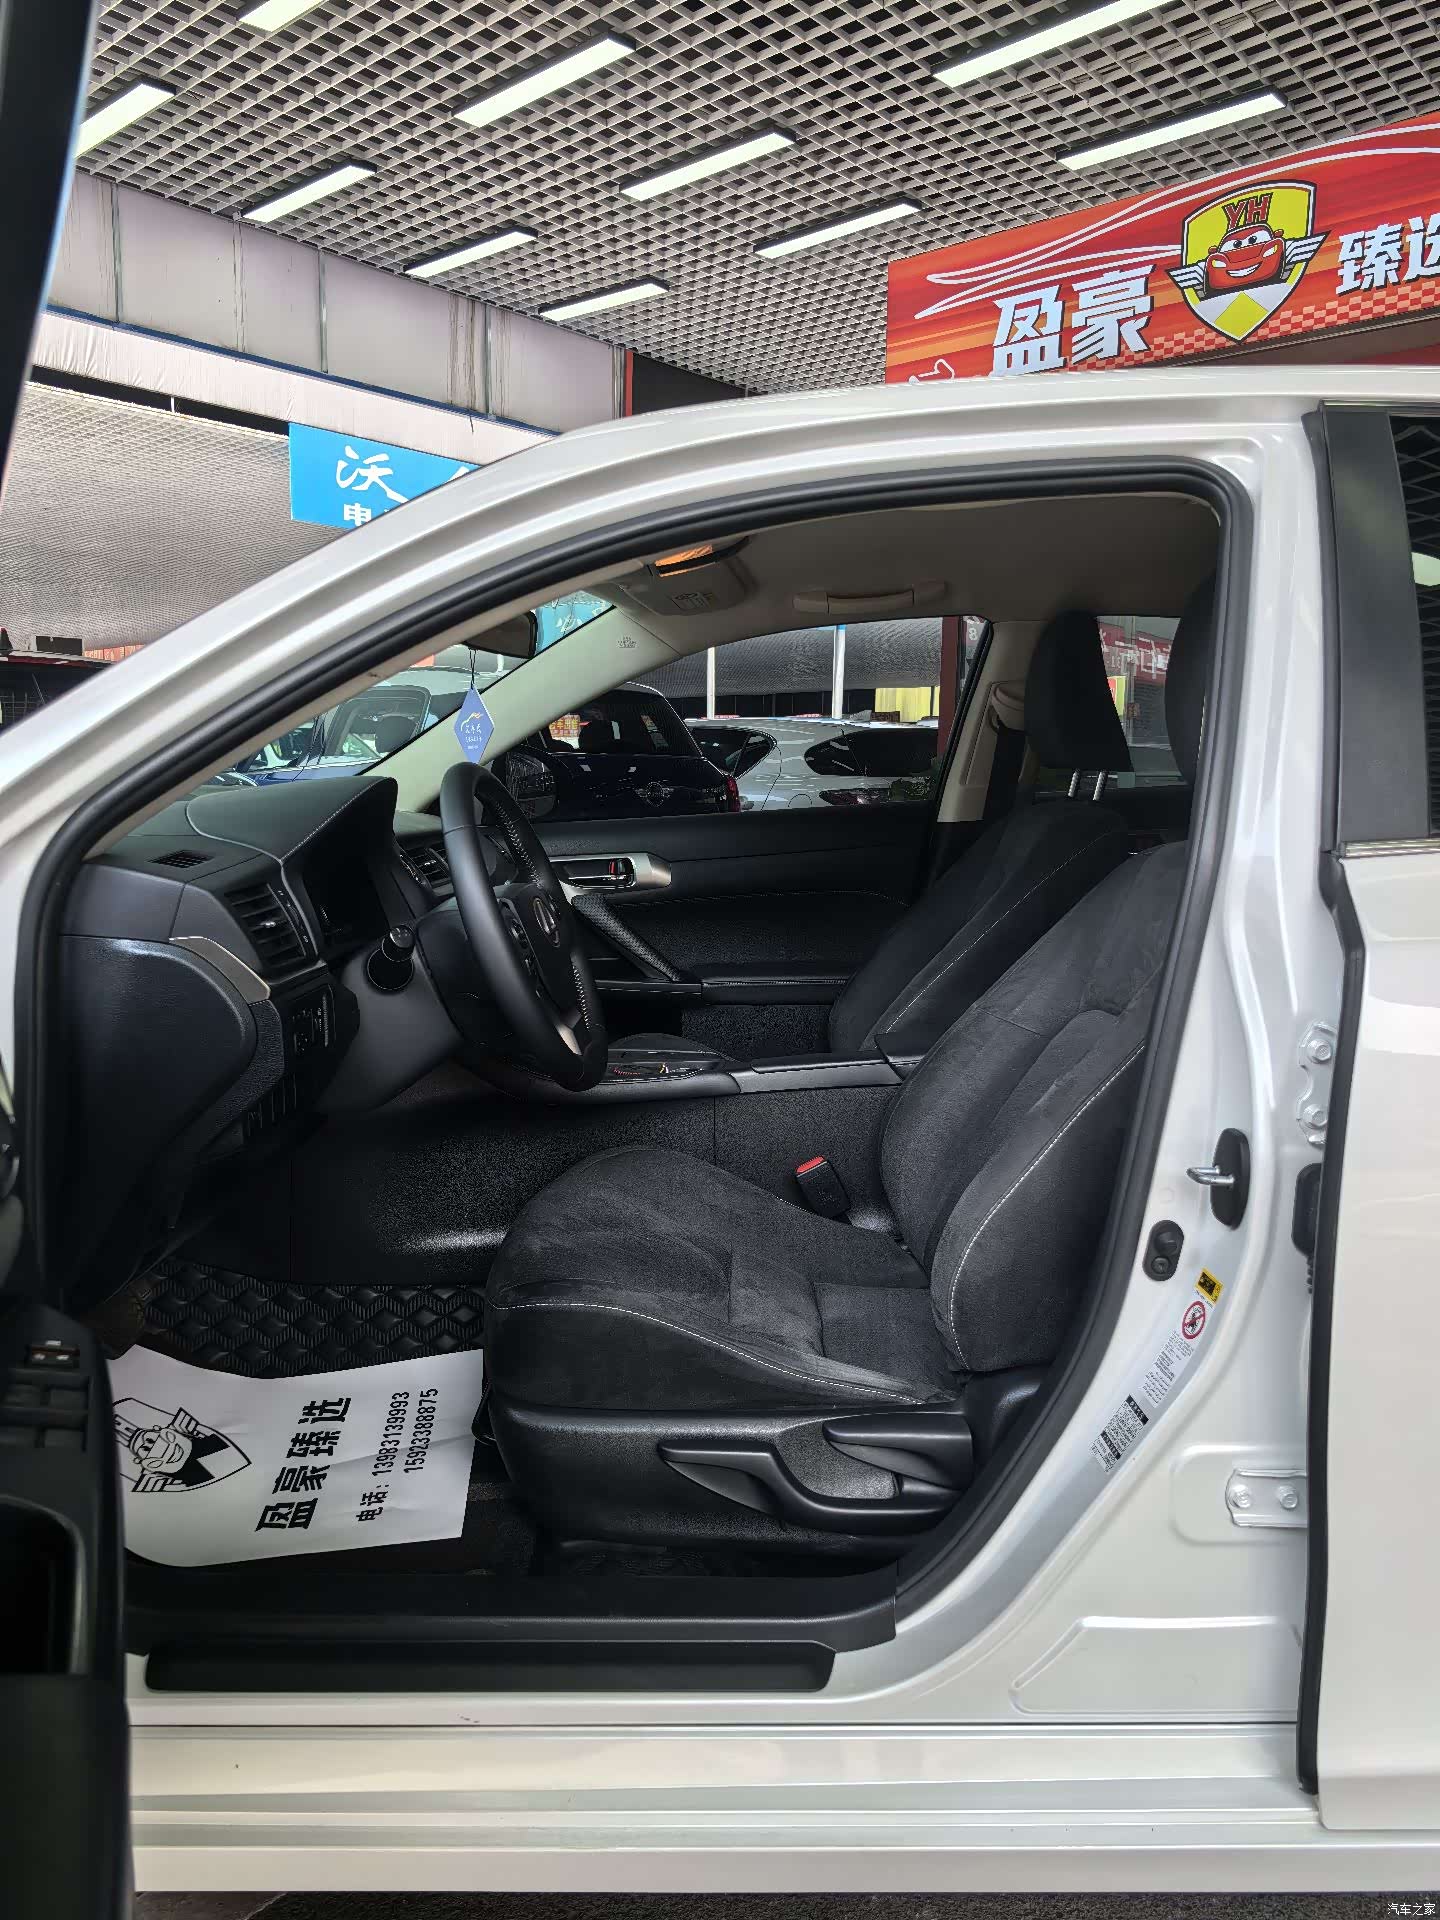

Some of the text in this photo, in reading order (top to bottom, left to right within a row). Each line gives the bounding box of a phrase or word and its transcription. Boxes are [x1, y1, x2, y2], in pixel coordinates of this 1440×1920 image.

[1222, 193, 1272, 231] YH
[988, 264, 1154, 377] 盈豪
[255, 1397, 351, 1532] 盈豪臻选
[404, 1387, 438, 1474] 15923388875
